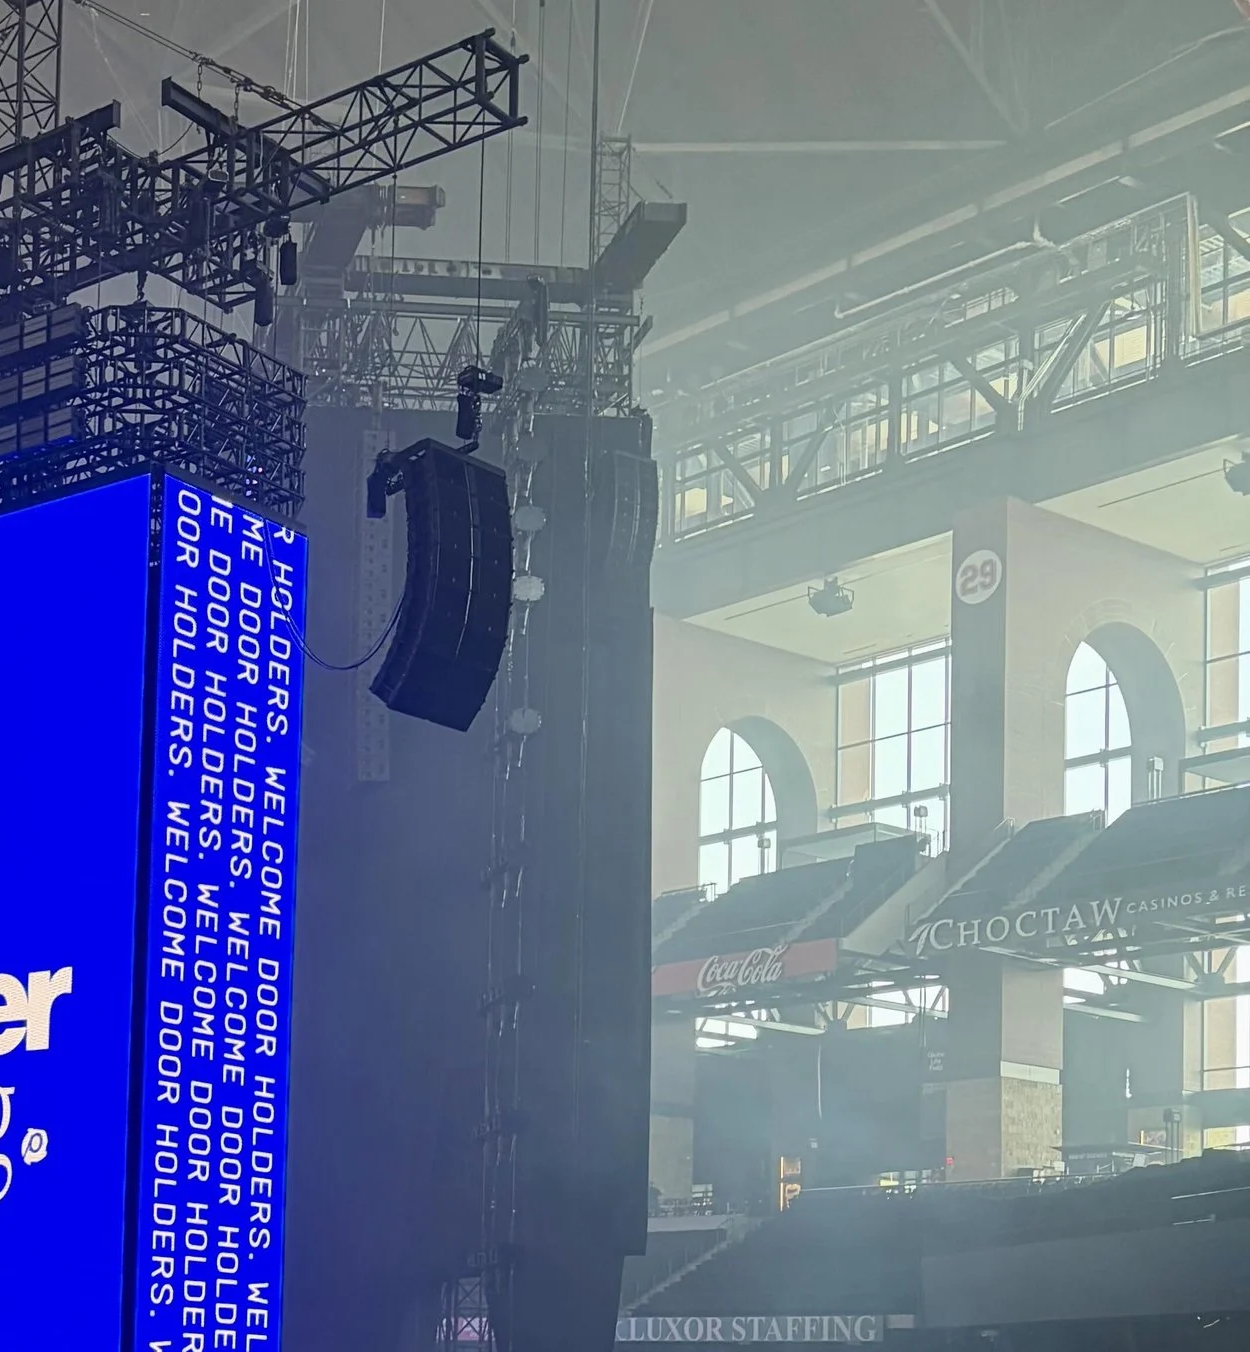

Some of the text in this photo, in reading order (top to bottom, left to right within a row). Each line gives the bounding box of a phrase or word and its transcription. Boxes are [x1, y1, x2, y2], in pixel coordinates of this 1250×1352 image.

[206, 549, 230, 653] DOOR
[238, 583, 261, 684] DOOR
[267, 560, 292, 742] HOLDERS.
[959, 558, 997, 597] 29
[169, 585, 197, 775] HOLDERS.
[199, 671, 226, 859] HOLDERS.
[230, 702, 257, 887] HOLDERS.
[260, 767, 285, 939] WELCOME
[162, 802, 189, 981] WELCOME
[192, 884, 219, 1060] WELCOME
[929, 897, 1124, 952] CHOCTAW
[1126, 891, 1203, 914] CASINOS
[1209, 889, 1219, 902] &
[158, 1001, 182, 1103] DOOR
[223, 912, 249, 1085] WELCOME
[256, 958, 279, 1056] DOOR
[188, 1081, 212, 1181] DOOR
[219, 1106, 242, 1205] DOOR
[249, 1076, 275, 1259] HOLDERS.
[150, 1125, 178, 1316] HOLDERS.
[629, 1315, 878, 1342] LUXOR STAFFING
